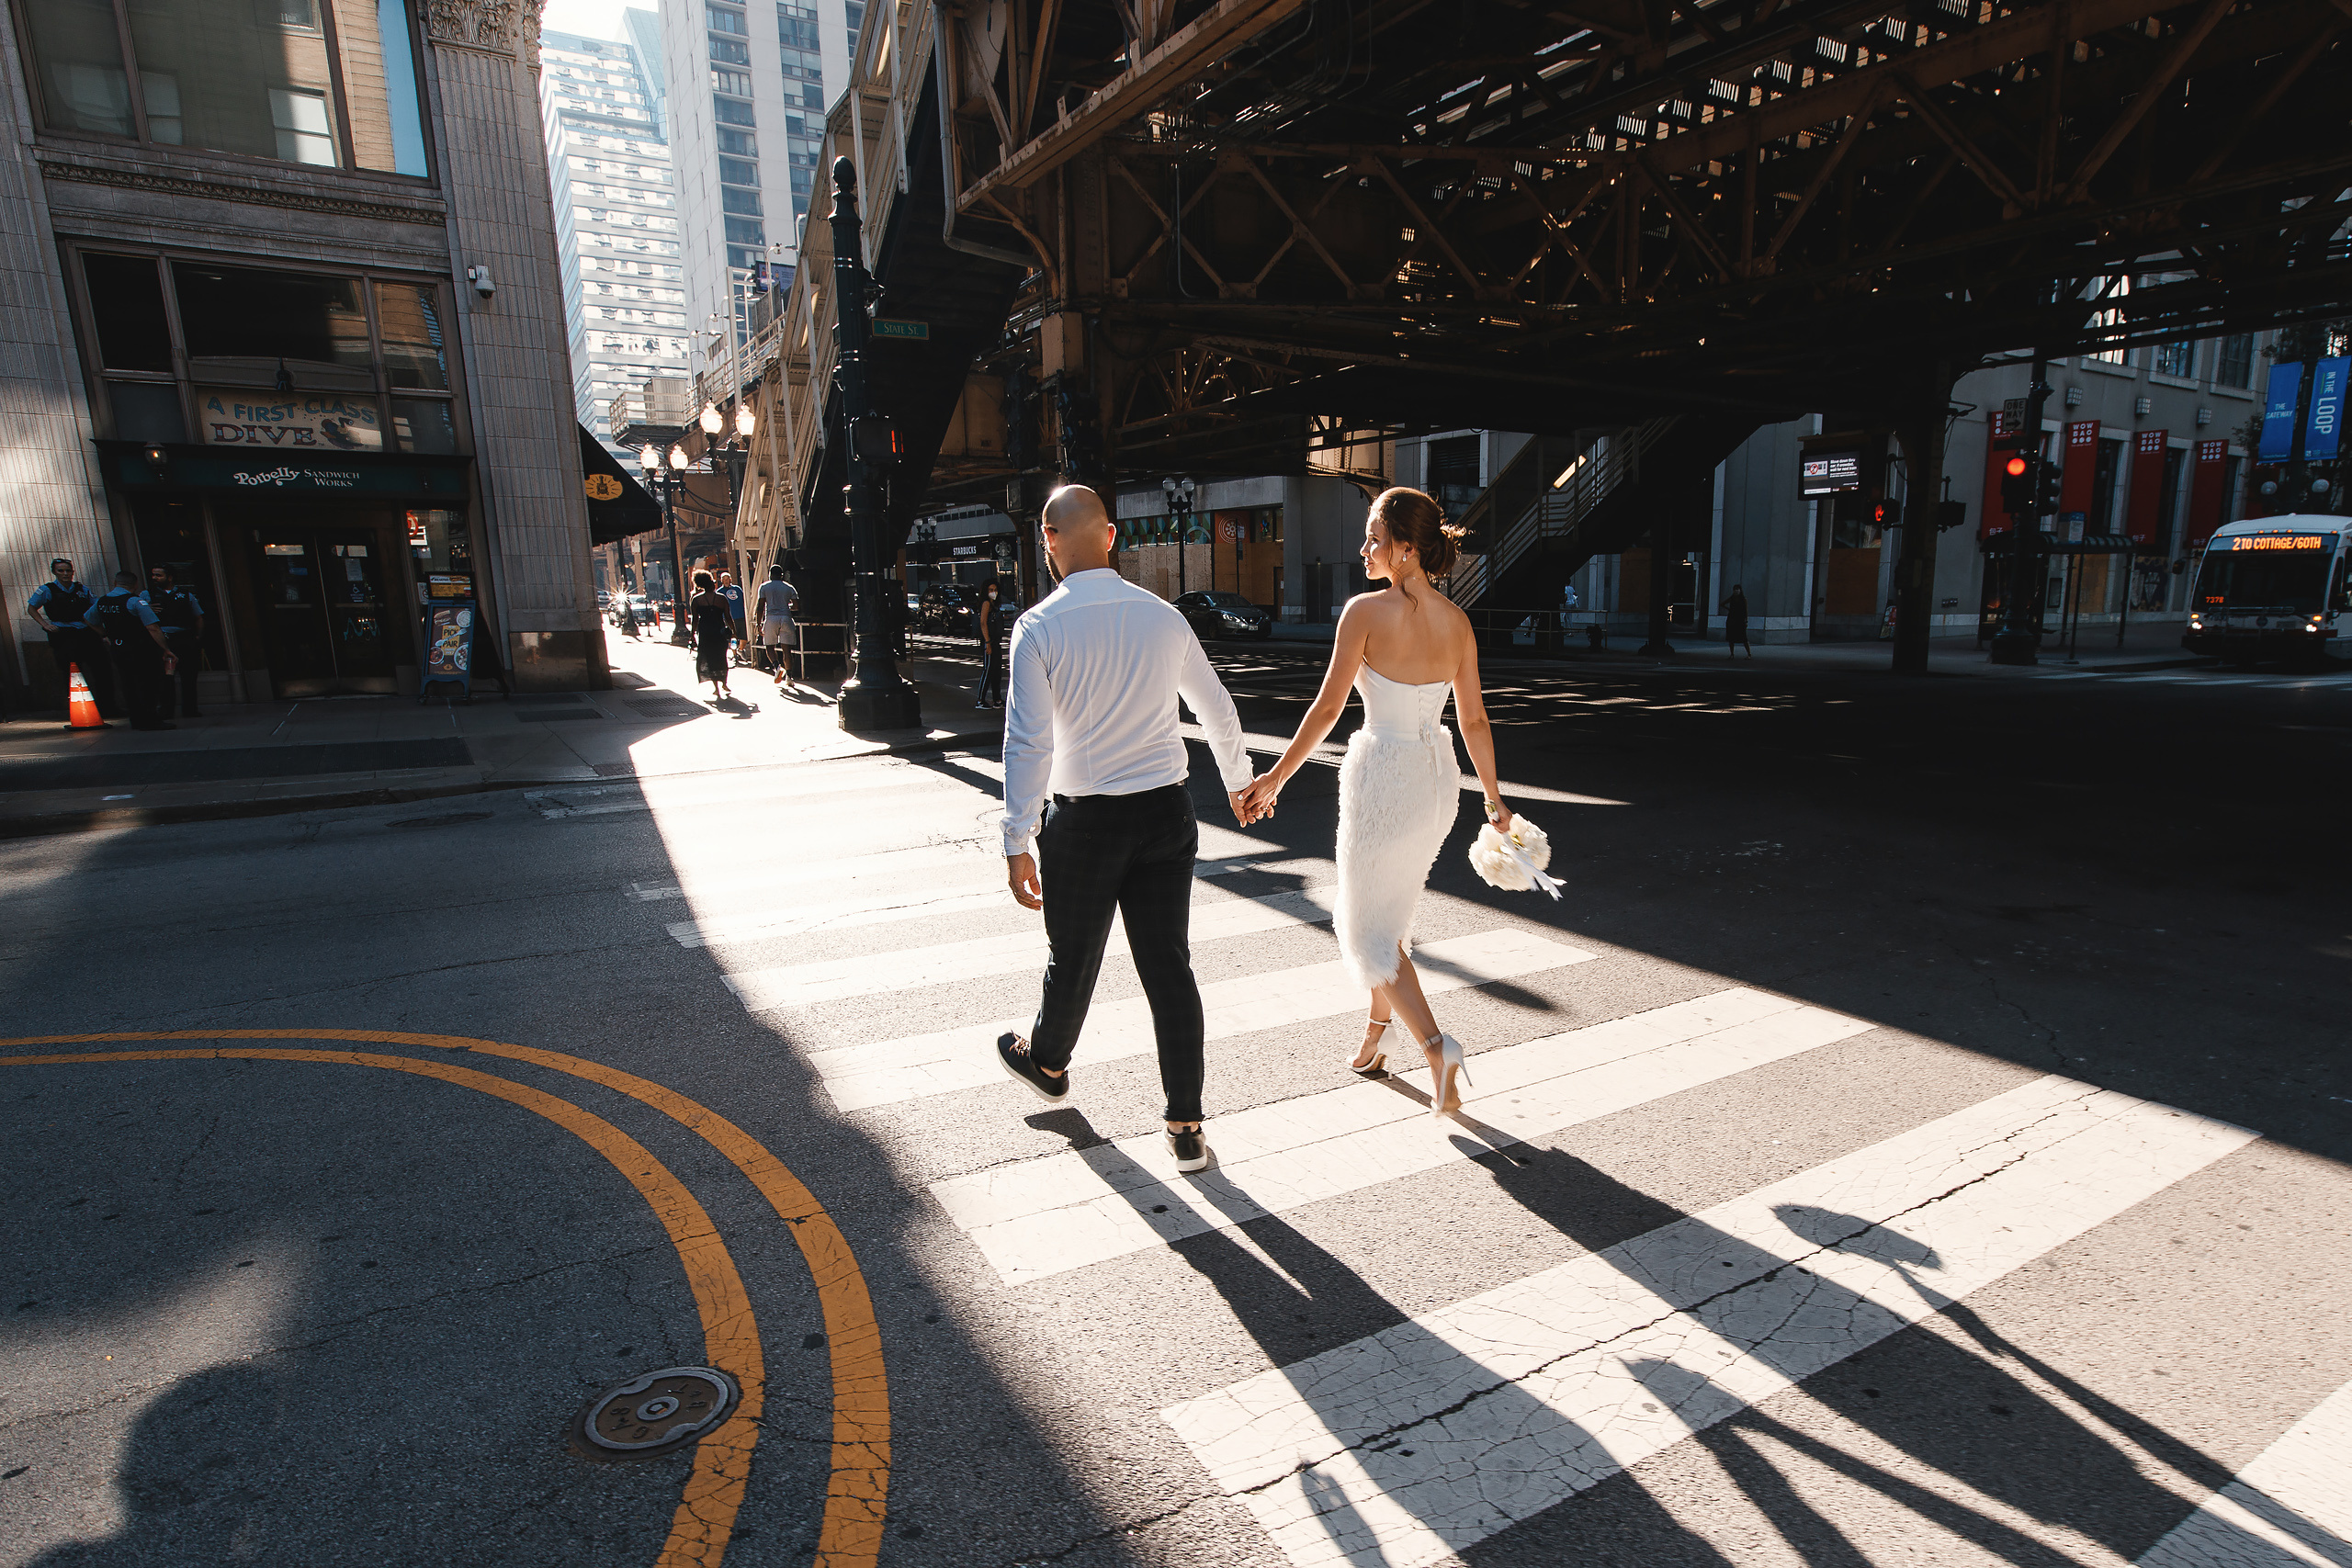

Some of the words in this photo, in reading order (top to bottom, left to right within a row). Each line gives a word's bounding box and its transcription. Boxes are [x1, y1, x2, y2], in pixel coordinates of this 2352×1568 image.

[884, 322, 905, 334] STATE
[908, 324, 920, 335] ST.
[2326, 371, 2336, 379] IN
[2324, 380, 2335, 394] THE
[208, 396, 225, 415] A
[233, 402, 298, 423] FIRST
[303, 398, 375, 424] CLASS
[2007, 400, 2024, 411] ONE
[2275, 402, 2286, 411] THE
[2006, 410, 2024, 419] WAY
[2266, 410, 2293, 420] GATEWAY
[2314, 396, 2337, 434] LOOP
[2073, 422, 2094, 430] WOW
[209, 423, 317, 446] DIVE
[2073, 429, 2093, 437] BAO
[233, 467, 300, 487] Potbelly
[303, 468, 360, 479] SANDWICH
[314, 478, 354, 488] WORKS
[2232, 537, 2241, 551] 2
[2253, 536, 2322, 550] COTTAGE/60TH
[953, 546, 977, 556] STARBUCKS
[98, 604, 120, 614] POLICE
